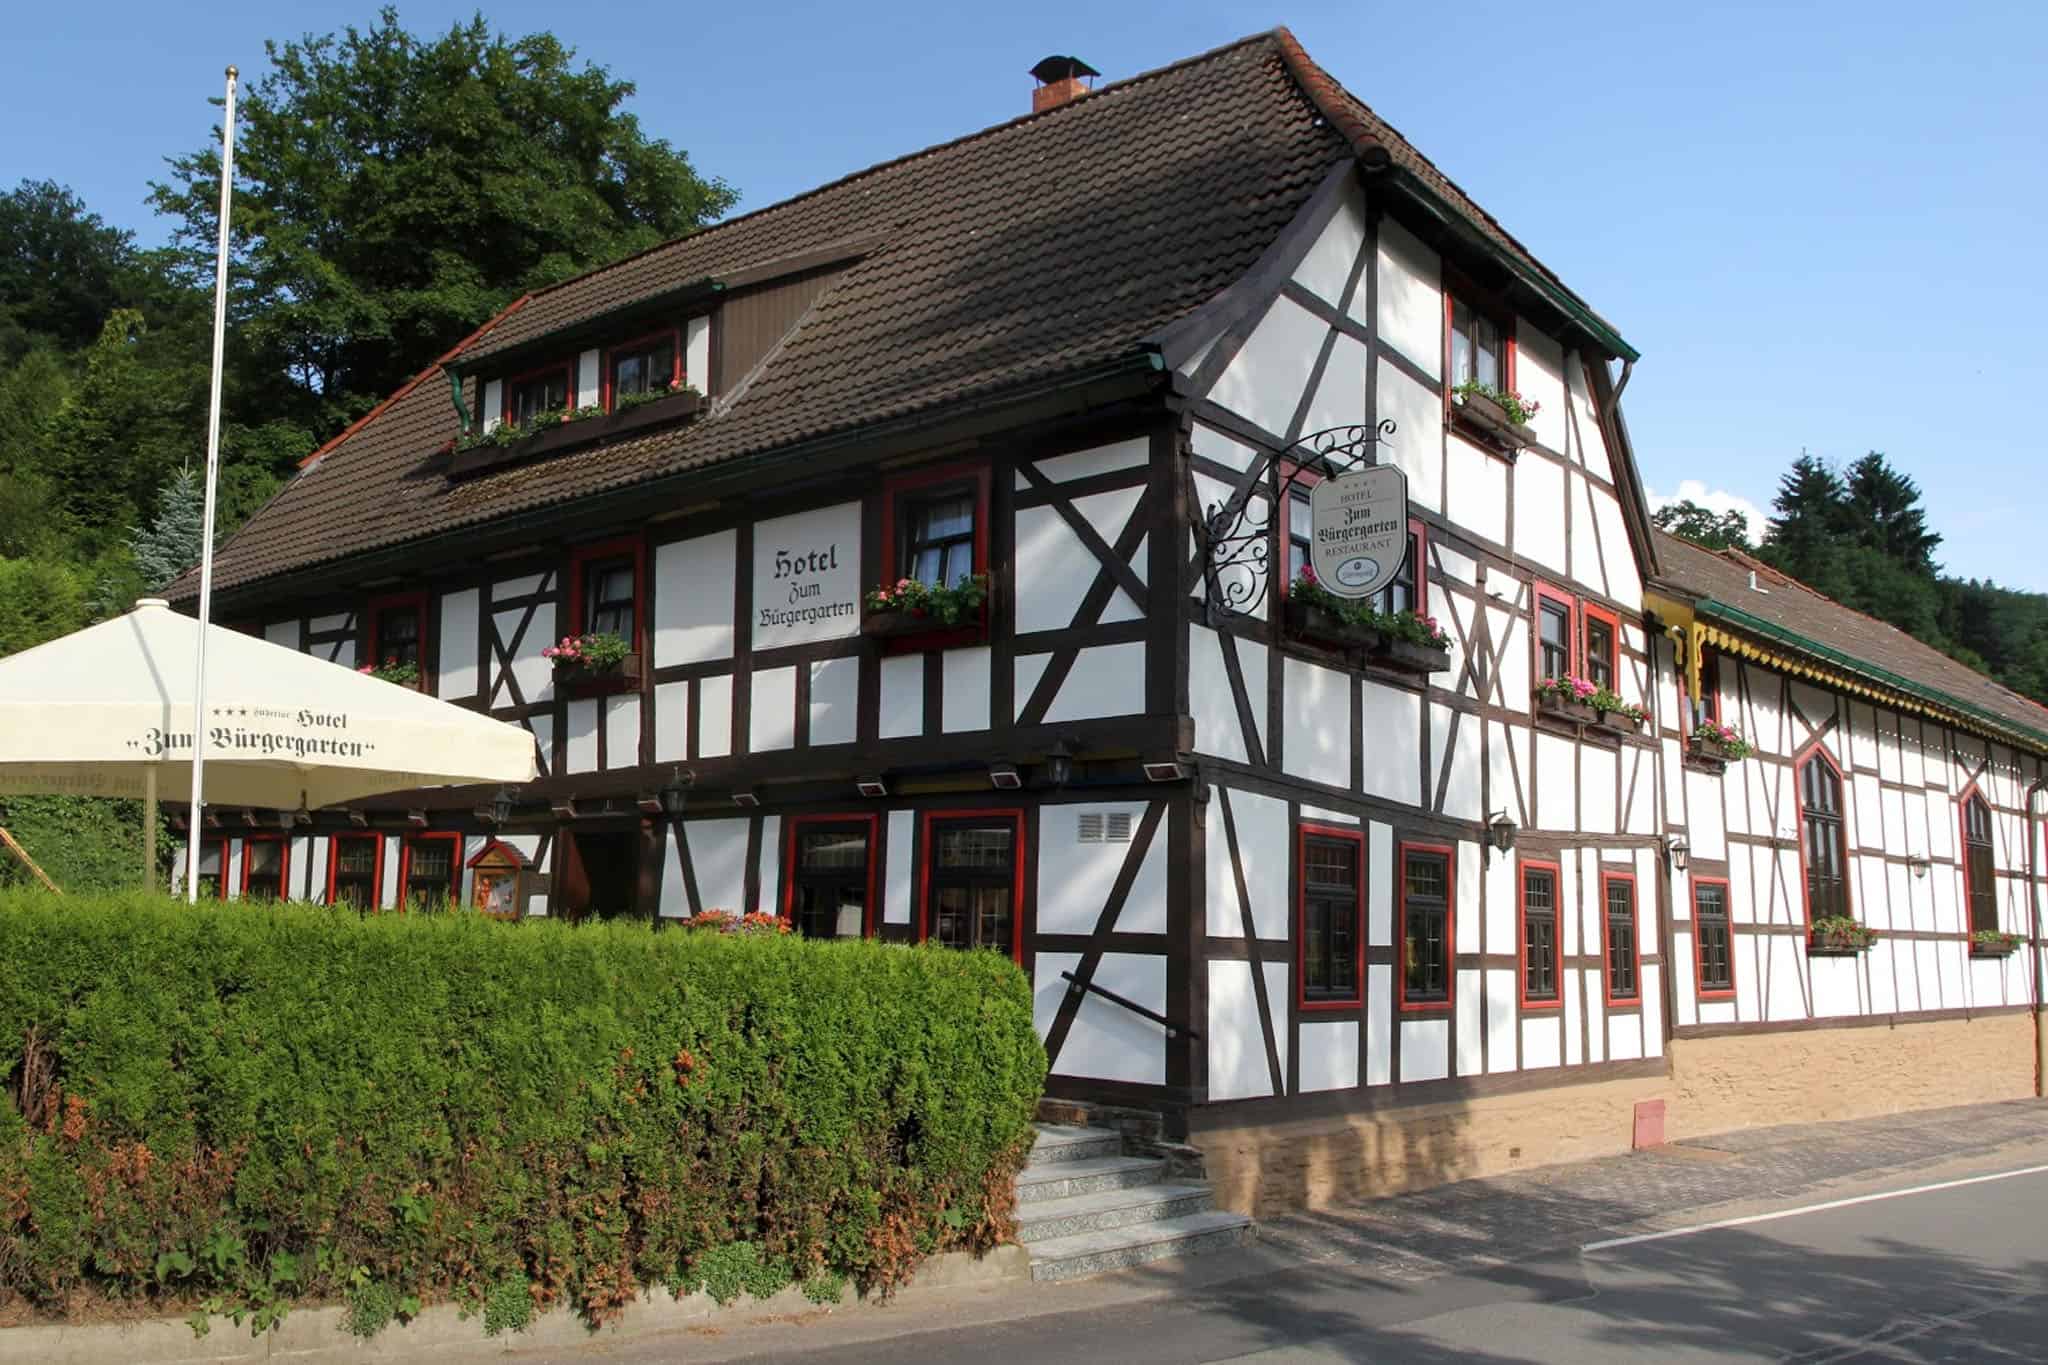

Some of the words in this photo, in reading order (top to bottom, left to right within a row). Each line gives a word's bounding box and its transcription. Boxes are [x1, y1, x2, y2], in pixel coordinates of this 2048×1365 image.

[1340, 489, 1373, 504] HOTEL
[1344, 507, 1371, 525] Zum
[1318, 520, 1398, 542] Bürgergarten
[1325, 538, 1392, 558] RESTAURANT
[774, 544, 838, 579] Hotel
[788, 581, 821, 605] Zum
[760, 602, 854, 627] Bürgergarten
[296, 709, 347, 729] Hotel
